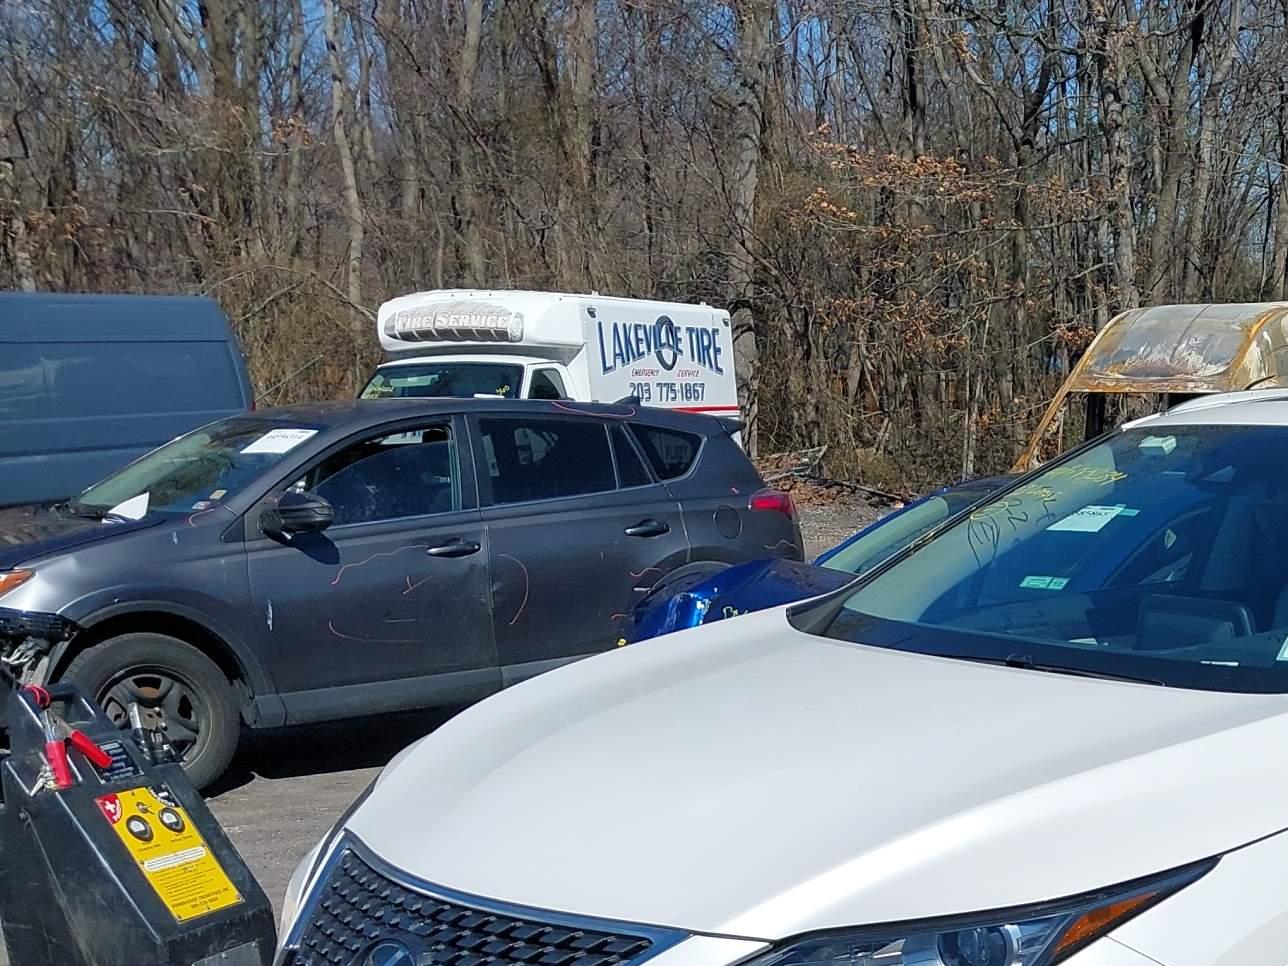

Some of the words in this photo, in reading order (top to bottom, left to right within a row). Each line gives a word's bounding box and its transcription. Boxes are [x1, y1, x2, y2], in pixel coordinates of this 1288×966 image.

[398, 314, 434, 331] TIRE
[434, 312, 508, 329] SERVICE
[685, 326, 724, 376] TIRE
[629, 382, 652, 402] 203
